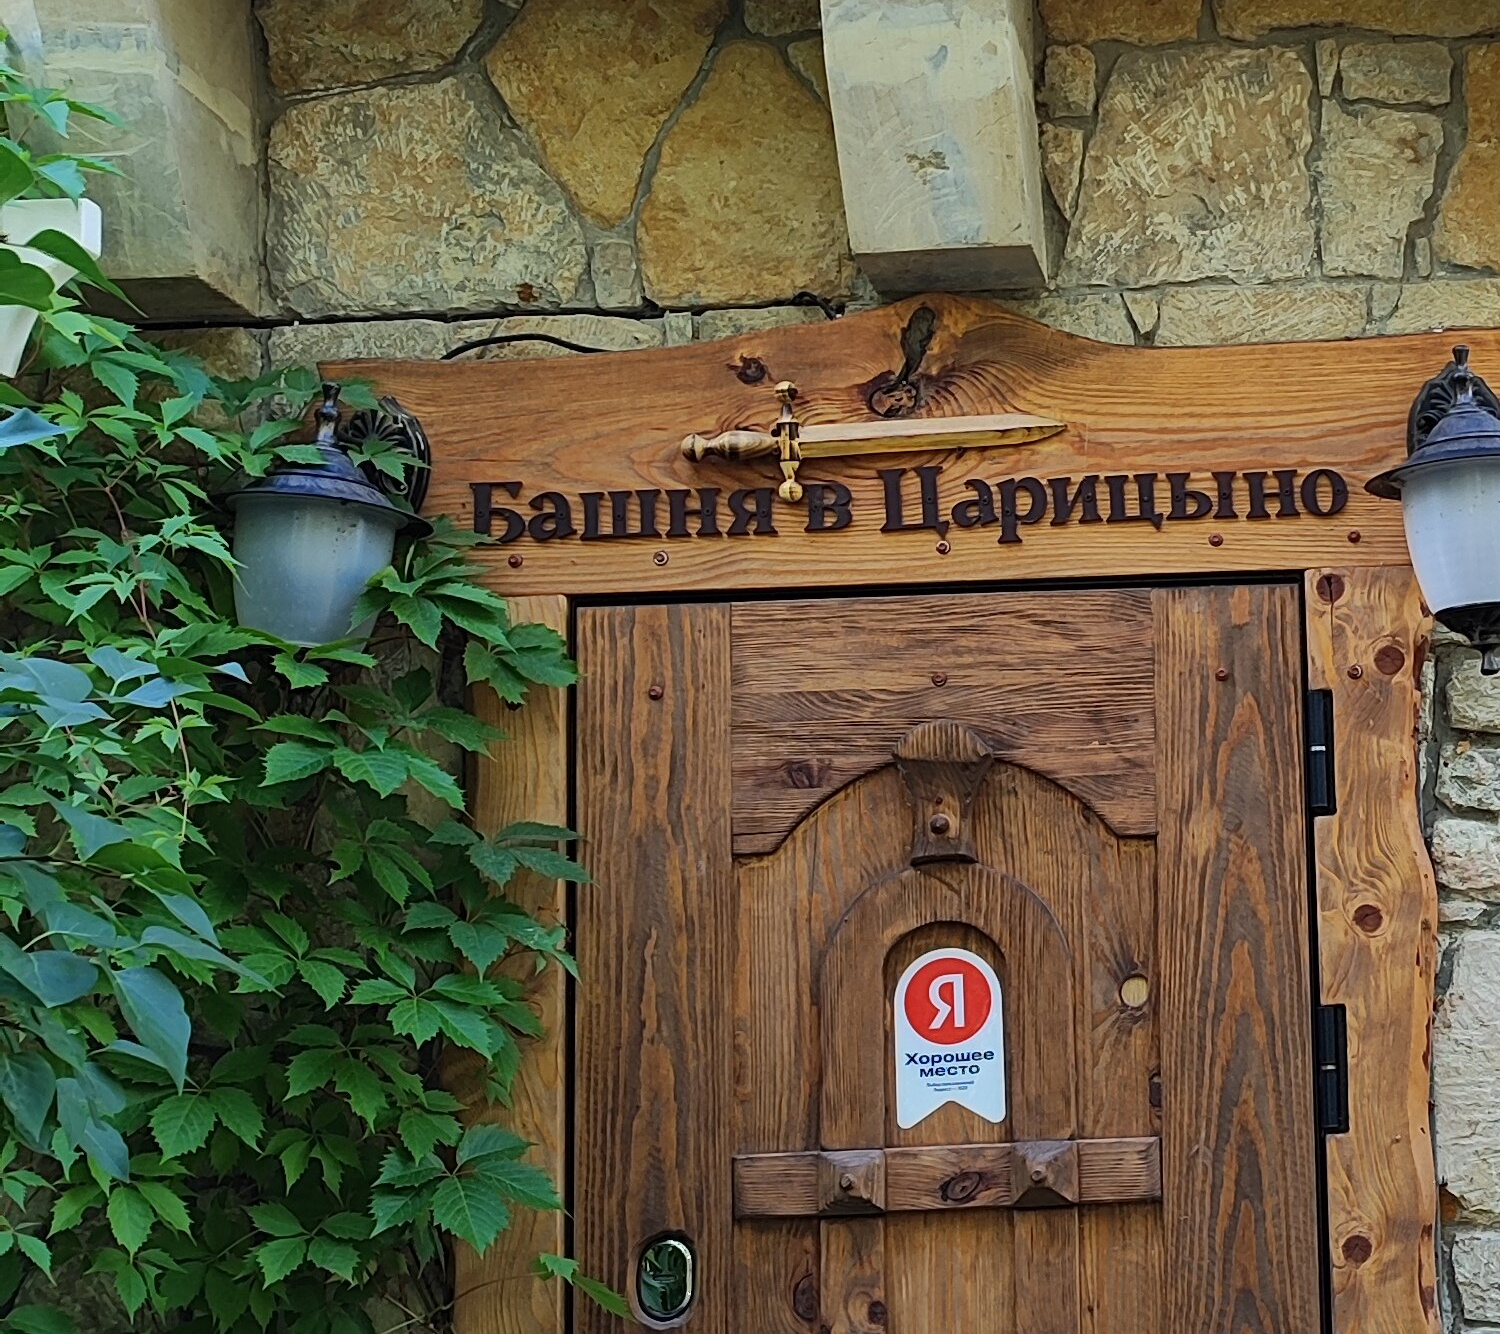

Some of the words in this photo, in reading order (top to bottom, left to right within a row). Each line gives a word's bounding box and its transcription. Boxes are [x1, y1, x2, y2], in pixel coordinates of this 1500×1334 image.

[469, 480, 779, 546] Башня
[803, 481, 853, 533] в
[876, 465, 1349, 544] Царицыно
[929, 974, 965, 1029] Я
[904, 1050, 995, 1066] Хорошее
[919, 1064, 980, 1077] место
